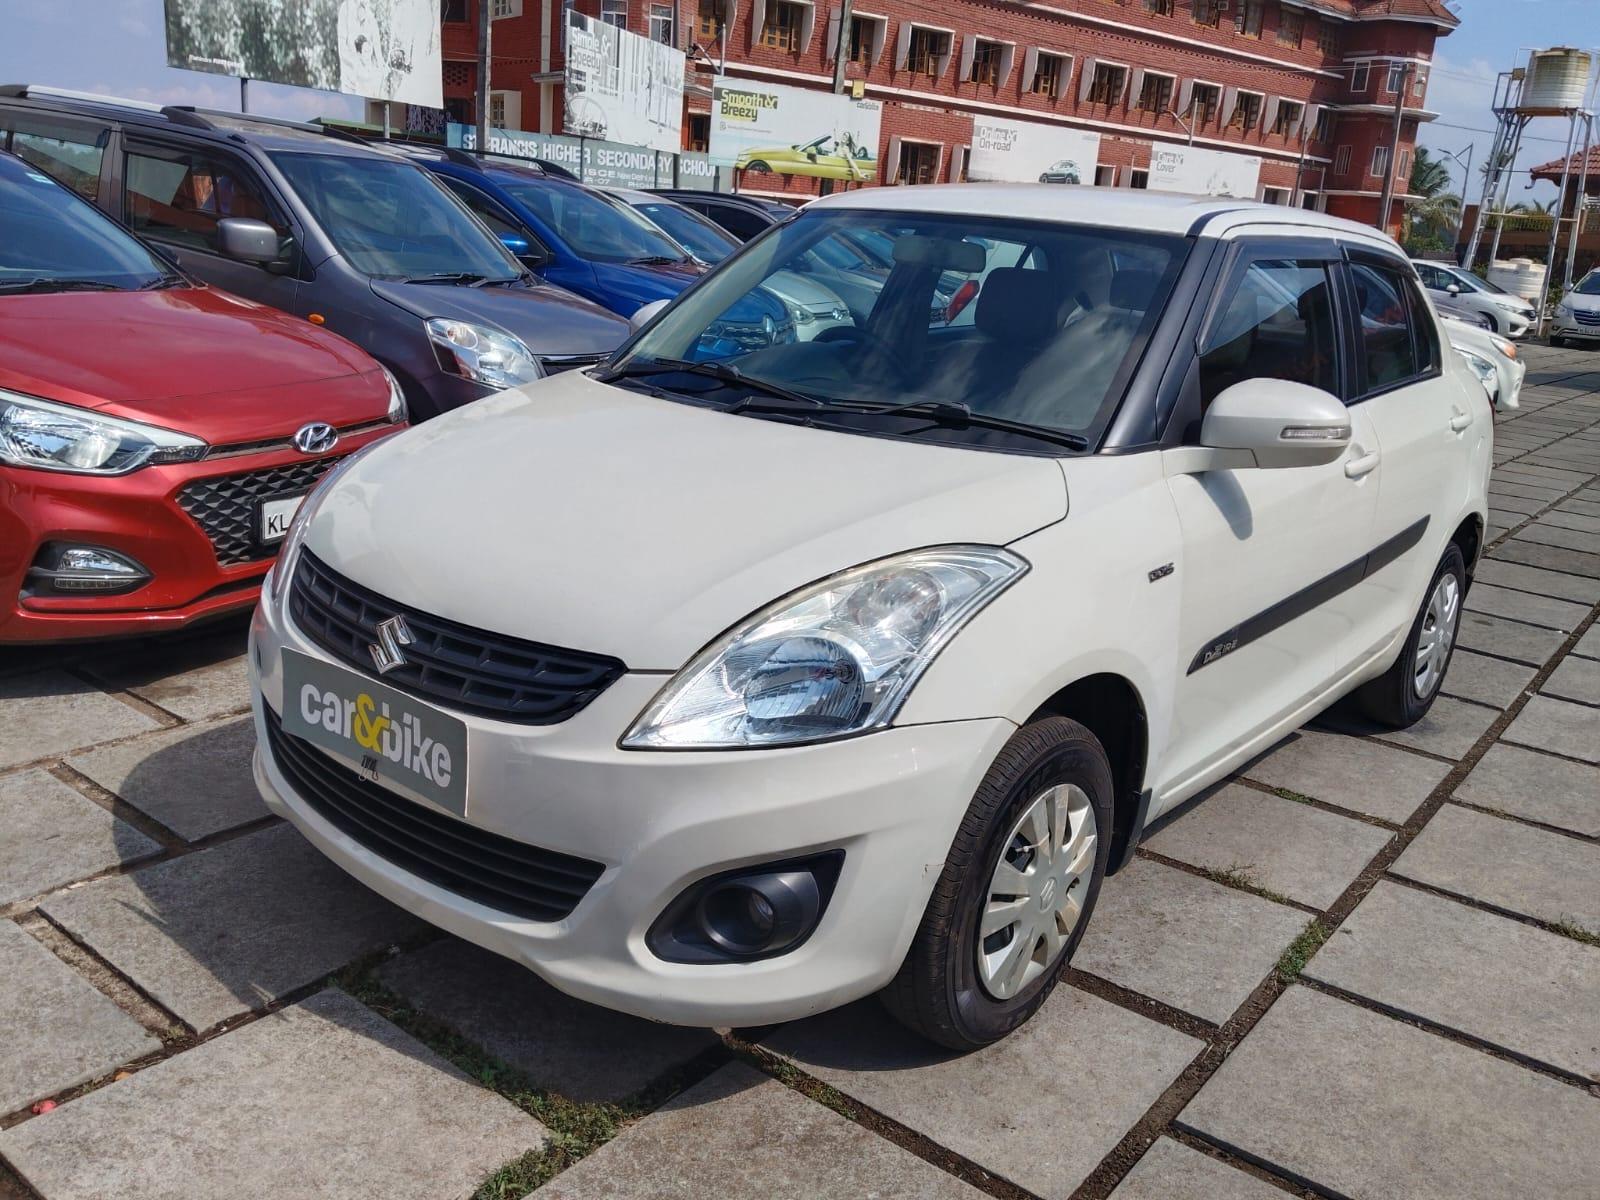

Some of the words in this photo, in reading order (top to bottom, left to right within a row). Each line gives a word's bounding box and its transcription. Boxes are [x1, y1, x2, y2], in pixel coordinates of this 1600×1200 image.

[721, 89, 763, 107] Smooth
[721, 102, 758, 122] Breezy
[979, 138, 1012, 152] On-road
[488, 138, 537, 158] RANCIS
[543, 142, 591, 164] HIGHER
[597, 149, 672, 173] SECONDARY
[300, 683, 452, 788] car&bike
